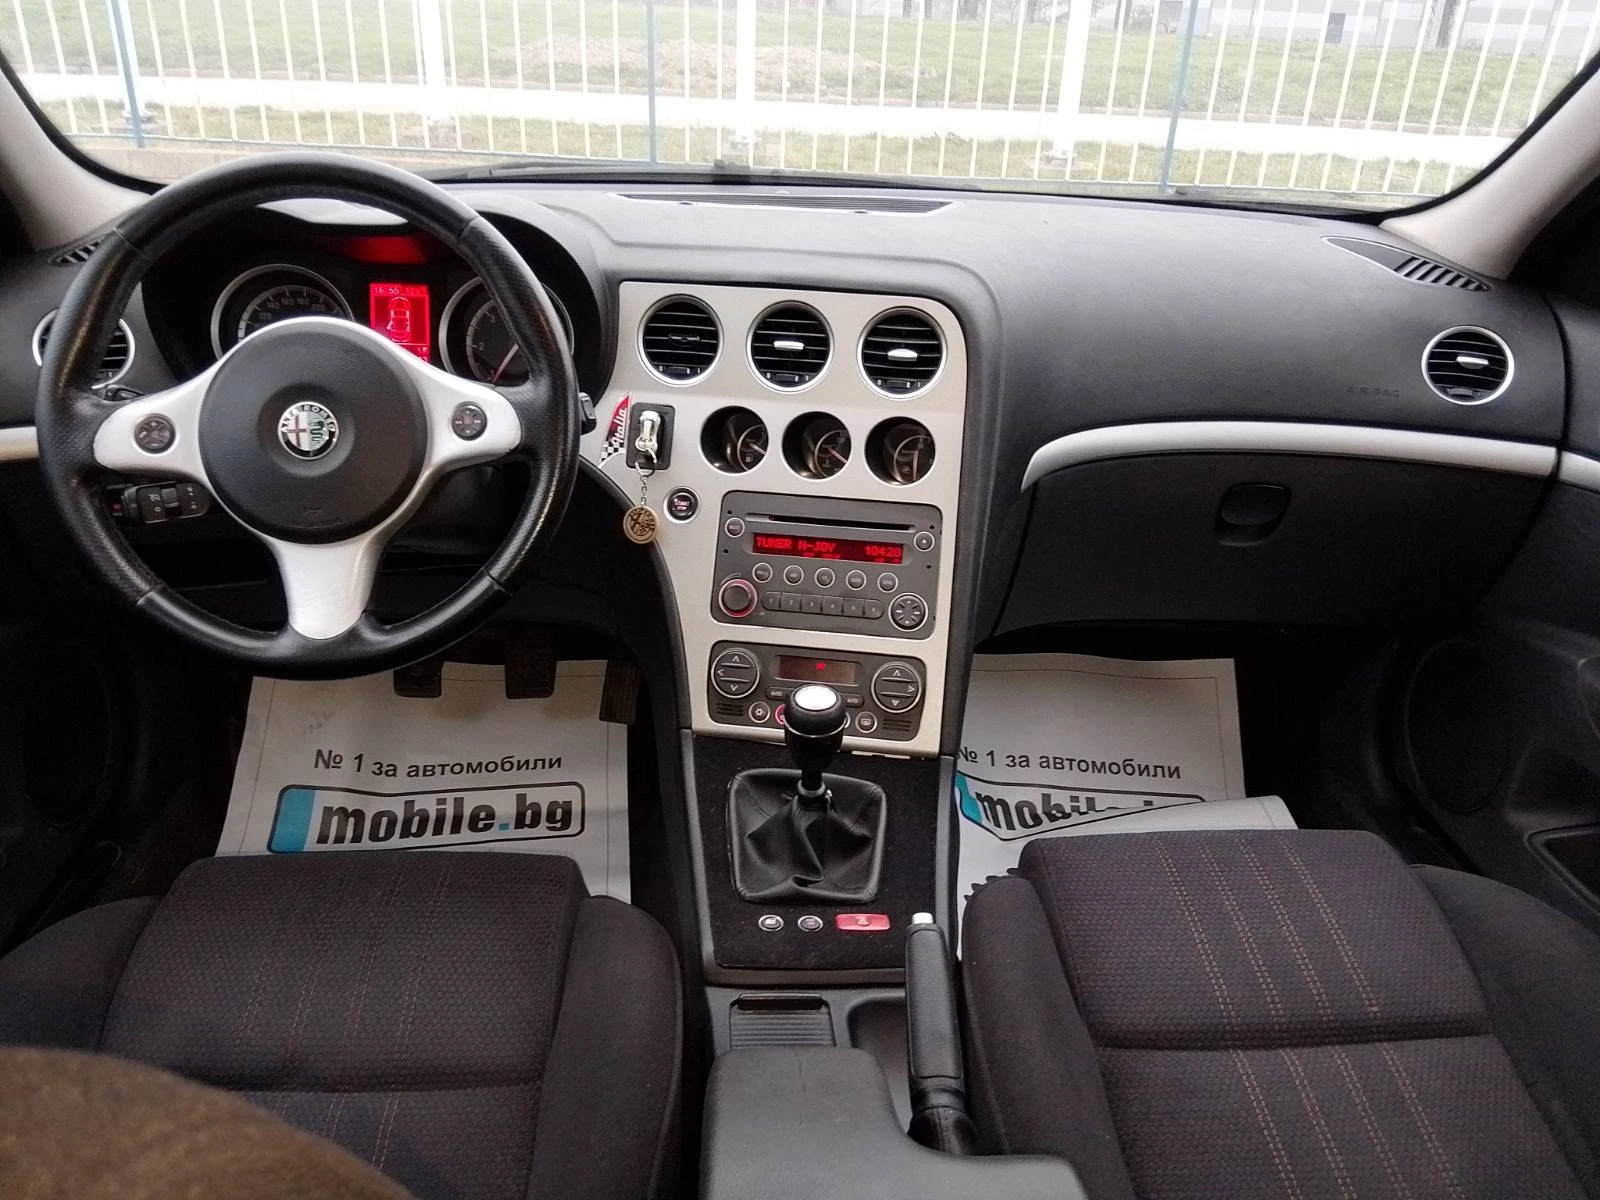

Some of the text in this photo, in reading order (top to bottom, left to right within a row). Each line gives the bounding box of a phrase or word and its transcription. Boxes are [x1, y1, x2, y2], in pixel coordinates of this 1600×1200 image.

[755, 536, 793, 550] TUNER
[798, 540, 836, 552] N-JOY
[314, 748, 562, 778] № 1 за автомобили
[986, 750, 996, 767] 1
[1005, 754, 1030, 768] за
[1039, 754, 1182, 779] автомобили
[316, 793, 573, 845] mobile.bg
